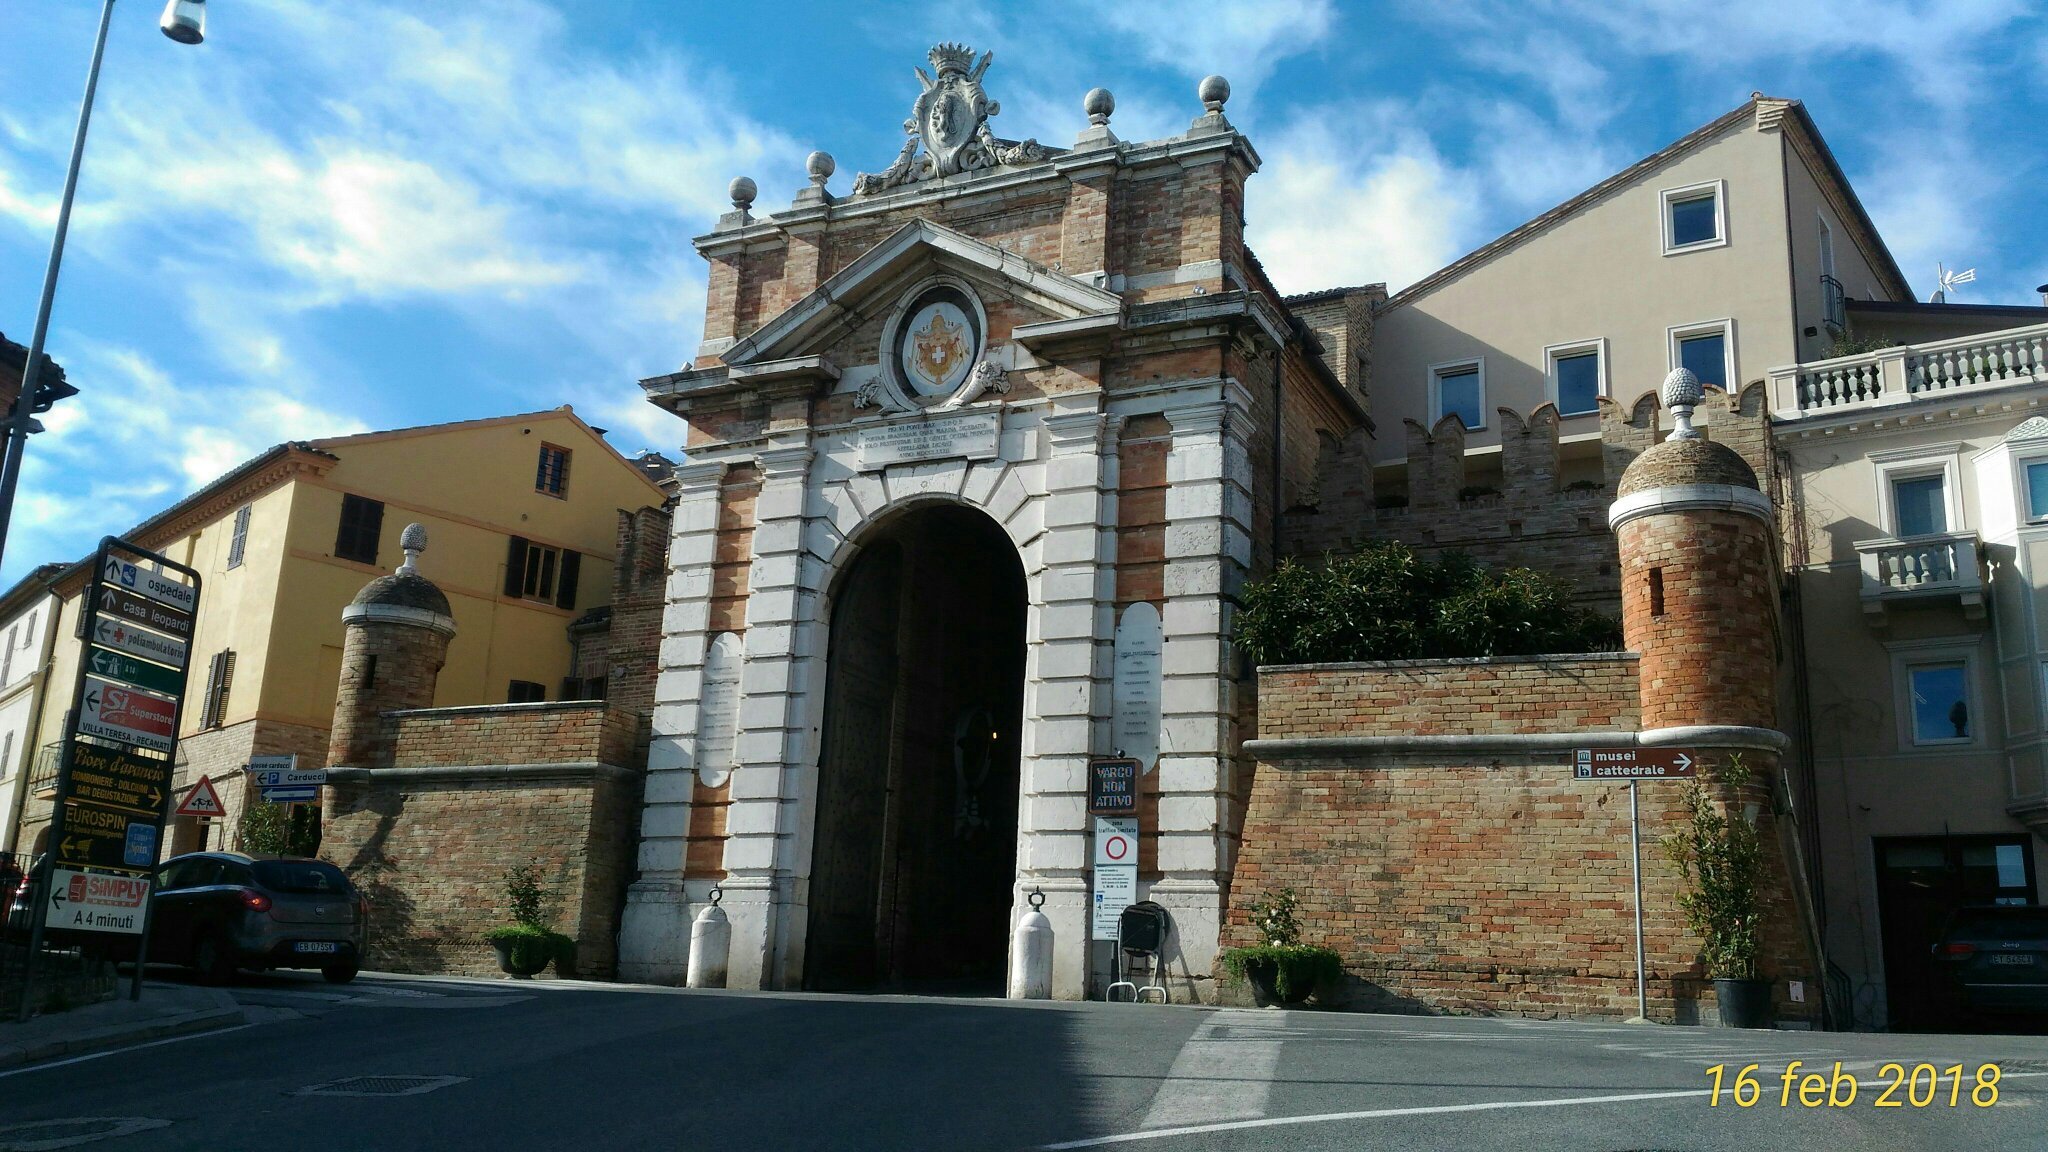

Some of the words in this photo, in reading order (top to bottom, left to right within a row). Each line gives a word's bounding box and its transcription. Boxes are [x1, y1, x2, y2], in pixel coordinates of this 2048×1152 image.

[148, 579, 192, 603] ospedale
[123, 601, 146, 618] casa
[151, 609, 190, 632] leopardi
[128, 634, 184, 658] poliambulatorio
[129, 705, 173, 725] Superstore
[82, 722, 104, 735] VILLA
[105, 728, 131, 742] TERESA
[136, 735, 170, 751] RECANATI
[1595, 750, 1636, 761] musei
[287, 773, 325, 781] Carducci
[1096, 767, 1133, 778] VARCO
[1596, 765, 1665, 776] cattedrale
[72, 770, 113, 788] BOMBONIERE
[118, 780, 149, 794] DOLCIUMI
[1102, 780, 1126, 792] NON
[76, 784, 91, 796] BAR
[91, 787, 140, 805] DEGUSTAZIONE
[1095, 795, 1132, 807] ATTIVO
[65, 807, 127, 831] EUROSPIN
[73, 910, 83, 925] A
[85, 911, 93, 925] 4
[96, 913, 134, 929] minuti
